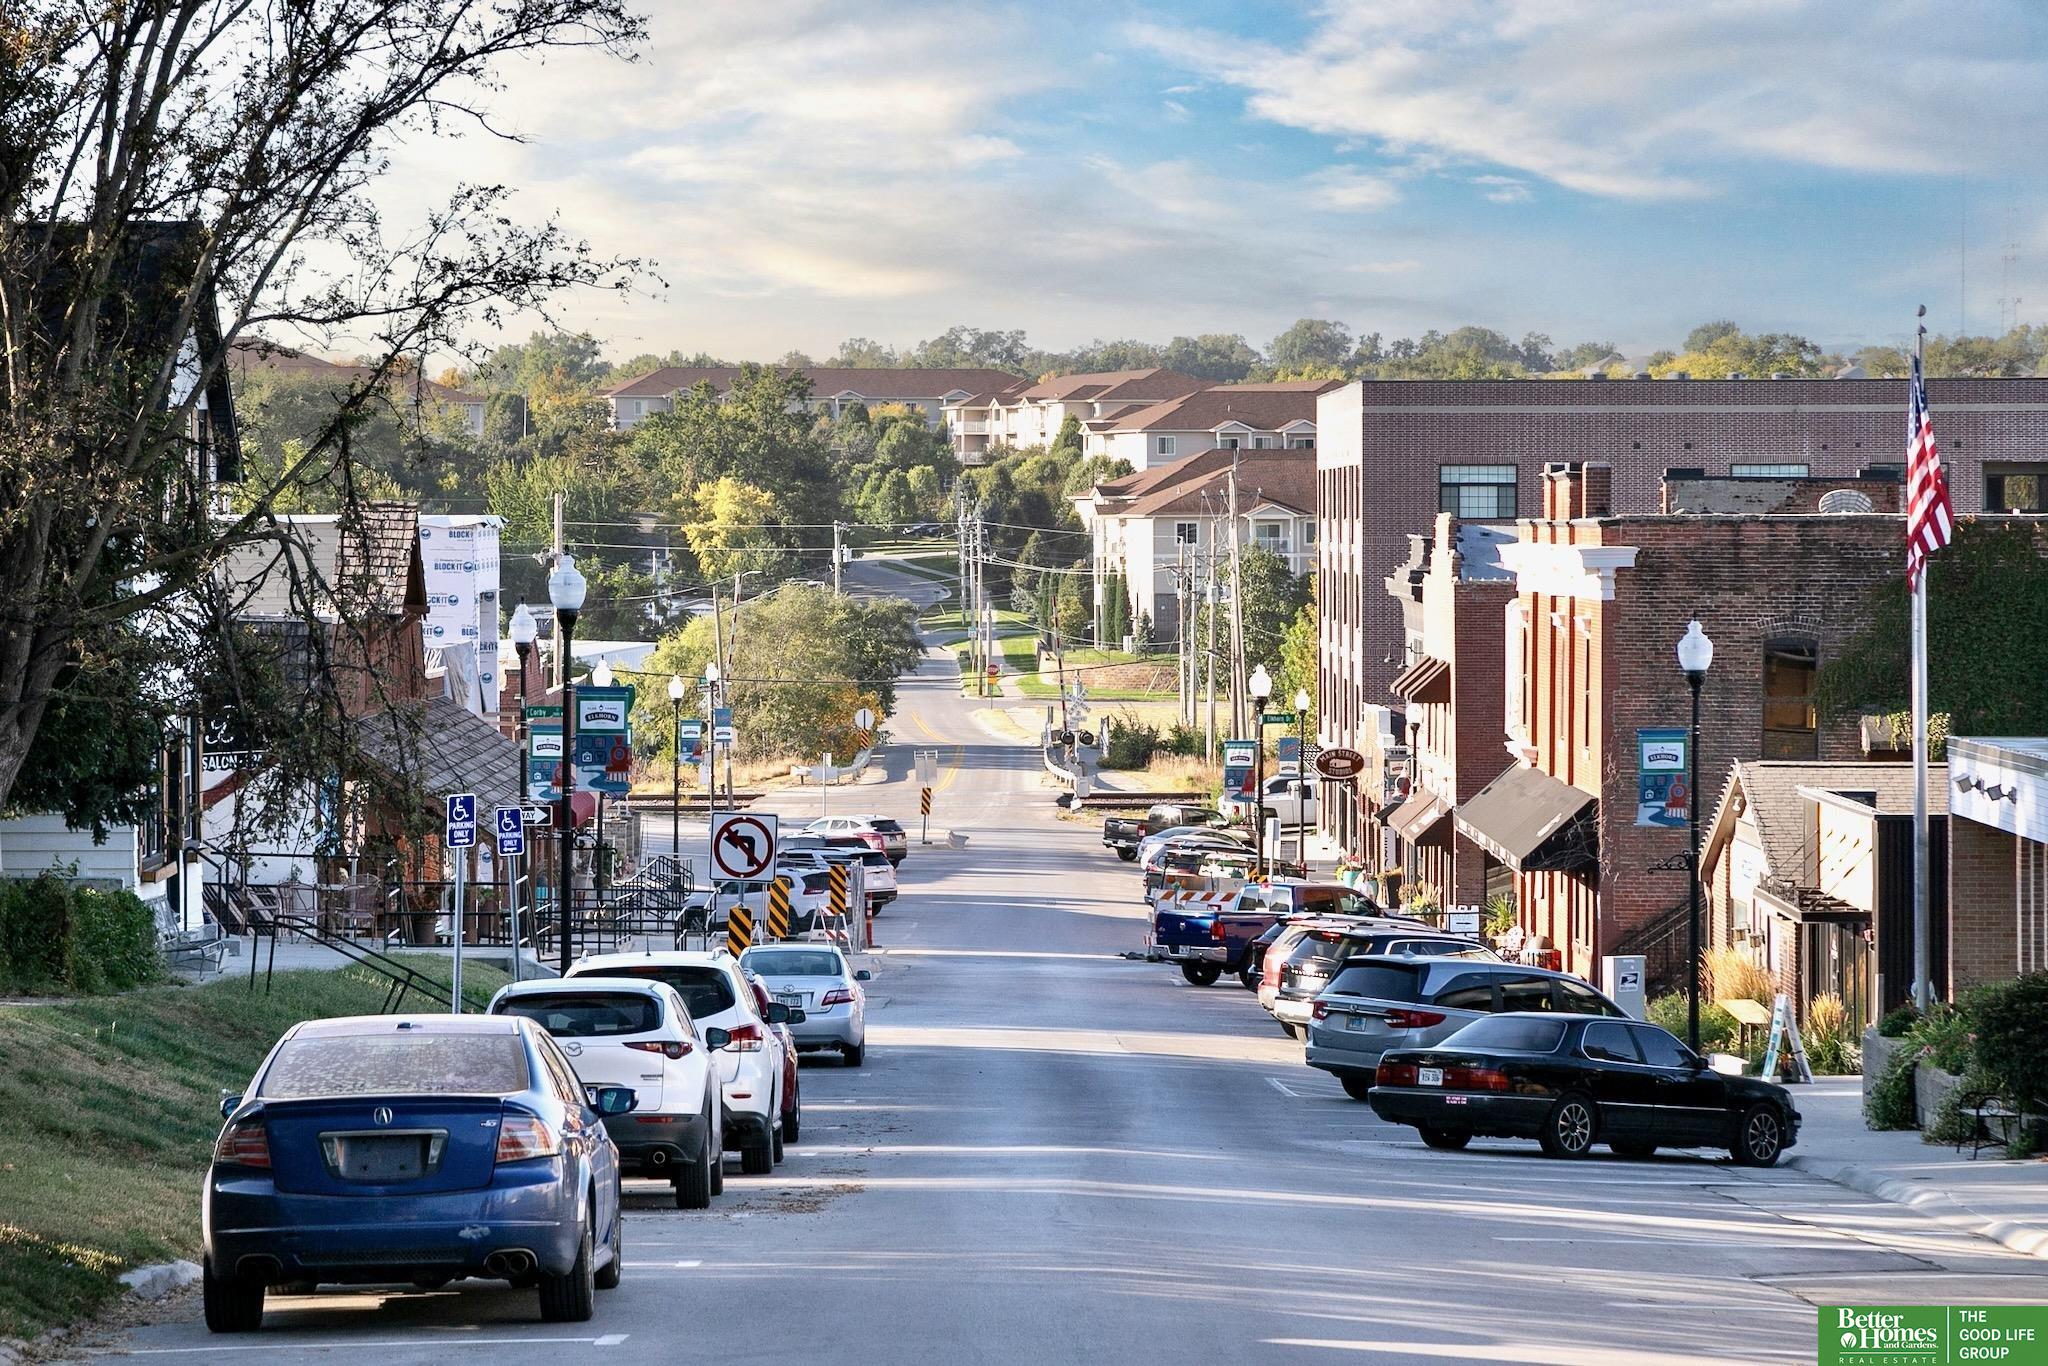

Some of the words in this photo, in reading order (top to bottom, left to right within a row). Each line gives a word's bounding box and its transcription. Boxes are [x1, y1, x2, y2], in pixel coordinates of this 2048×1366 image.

[587, 712, 617, 720] ELKHORN
[1320, 751, 1336, 762] MAIN
[1338, 750, 1361, 761] STREET
[1650, 753, 1676, 761] ELKHORN
[202, 754, 238, 770] SALON
[449, 821, 474, 830] PARKING
[454, 829, 469, 838] ONLY
[499, 831, 521, 839] PARKING
[503, 839, 518, 847] ONLY
